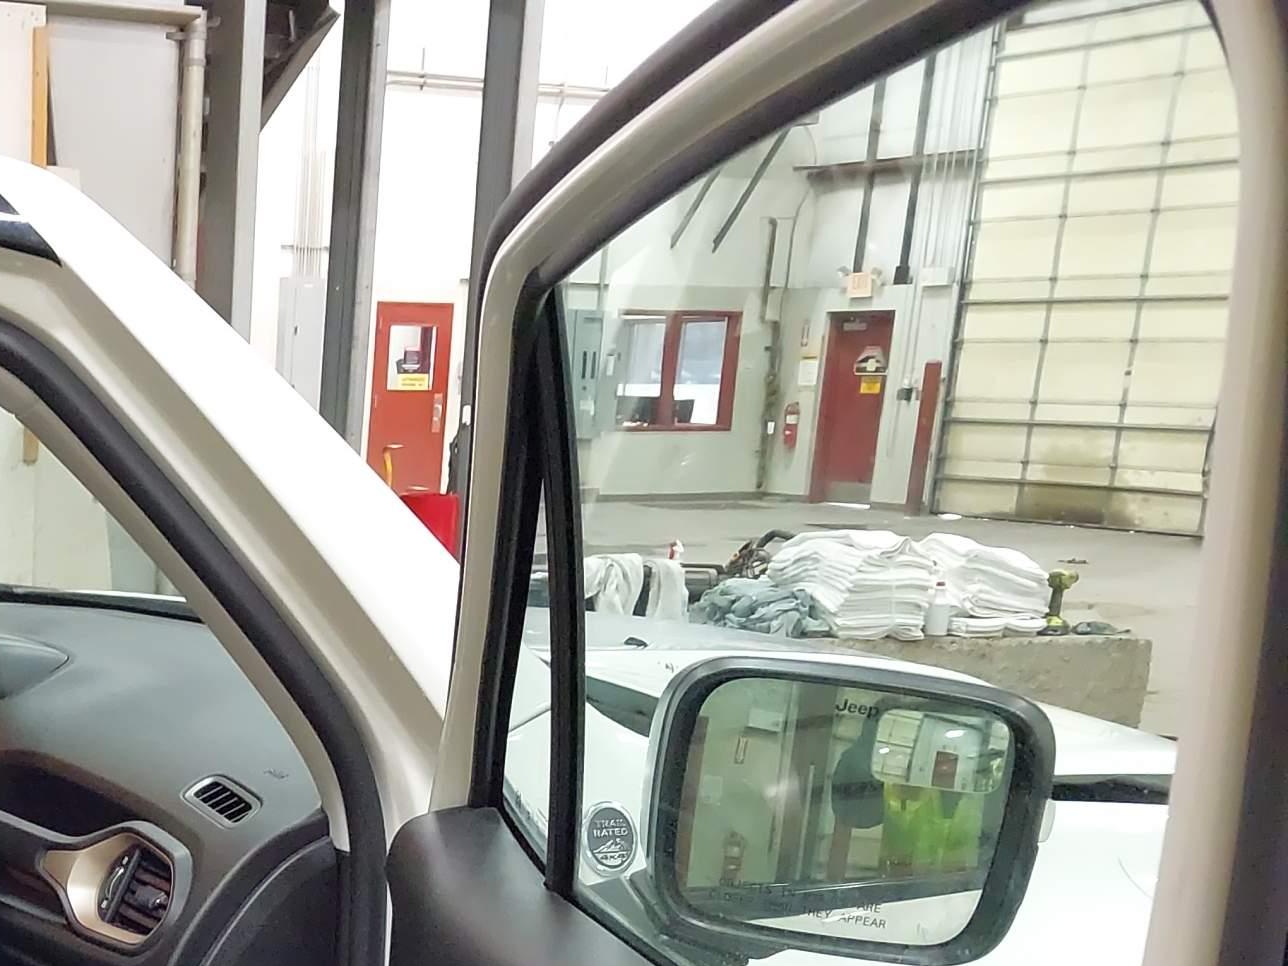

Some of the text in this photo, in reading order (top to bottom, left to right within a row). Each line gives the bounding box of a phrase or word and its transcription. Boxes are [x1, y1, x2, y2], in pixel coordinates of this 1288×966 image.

[835, 698, 880, 719] Jeep
[592, 827, 629, 838] RATED
[838, 912, 887, 929] APPEAR
